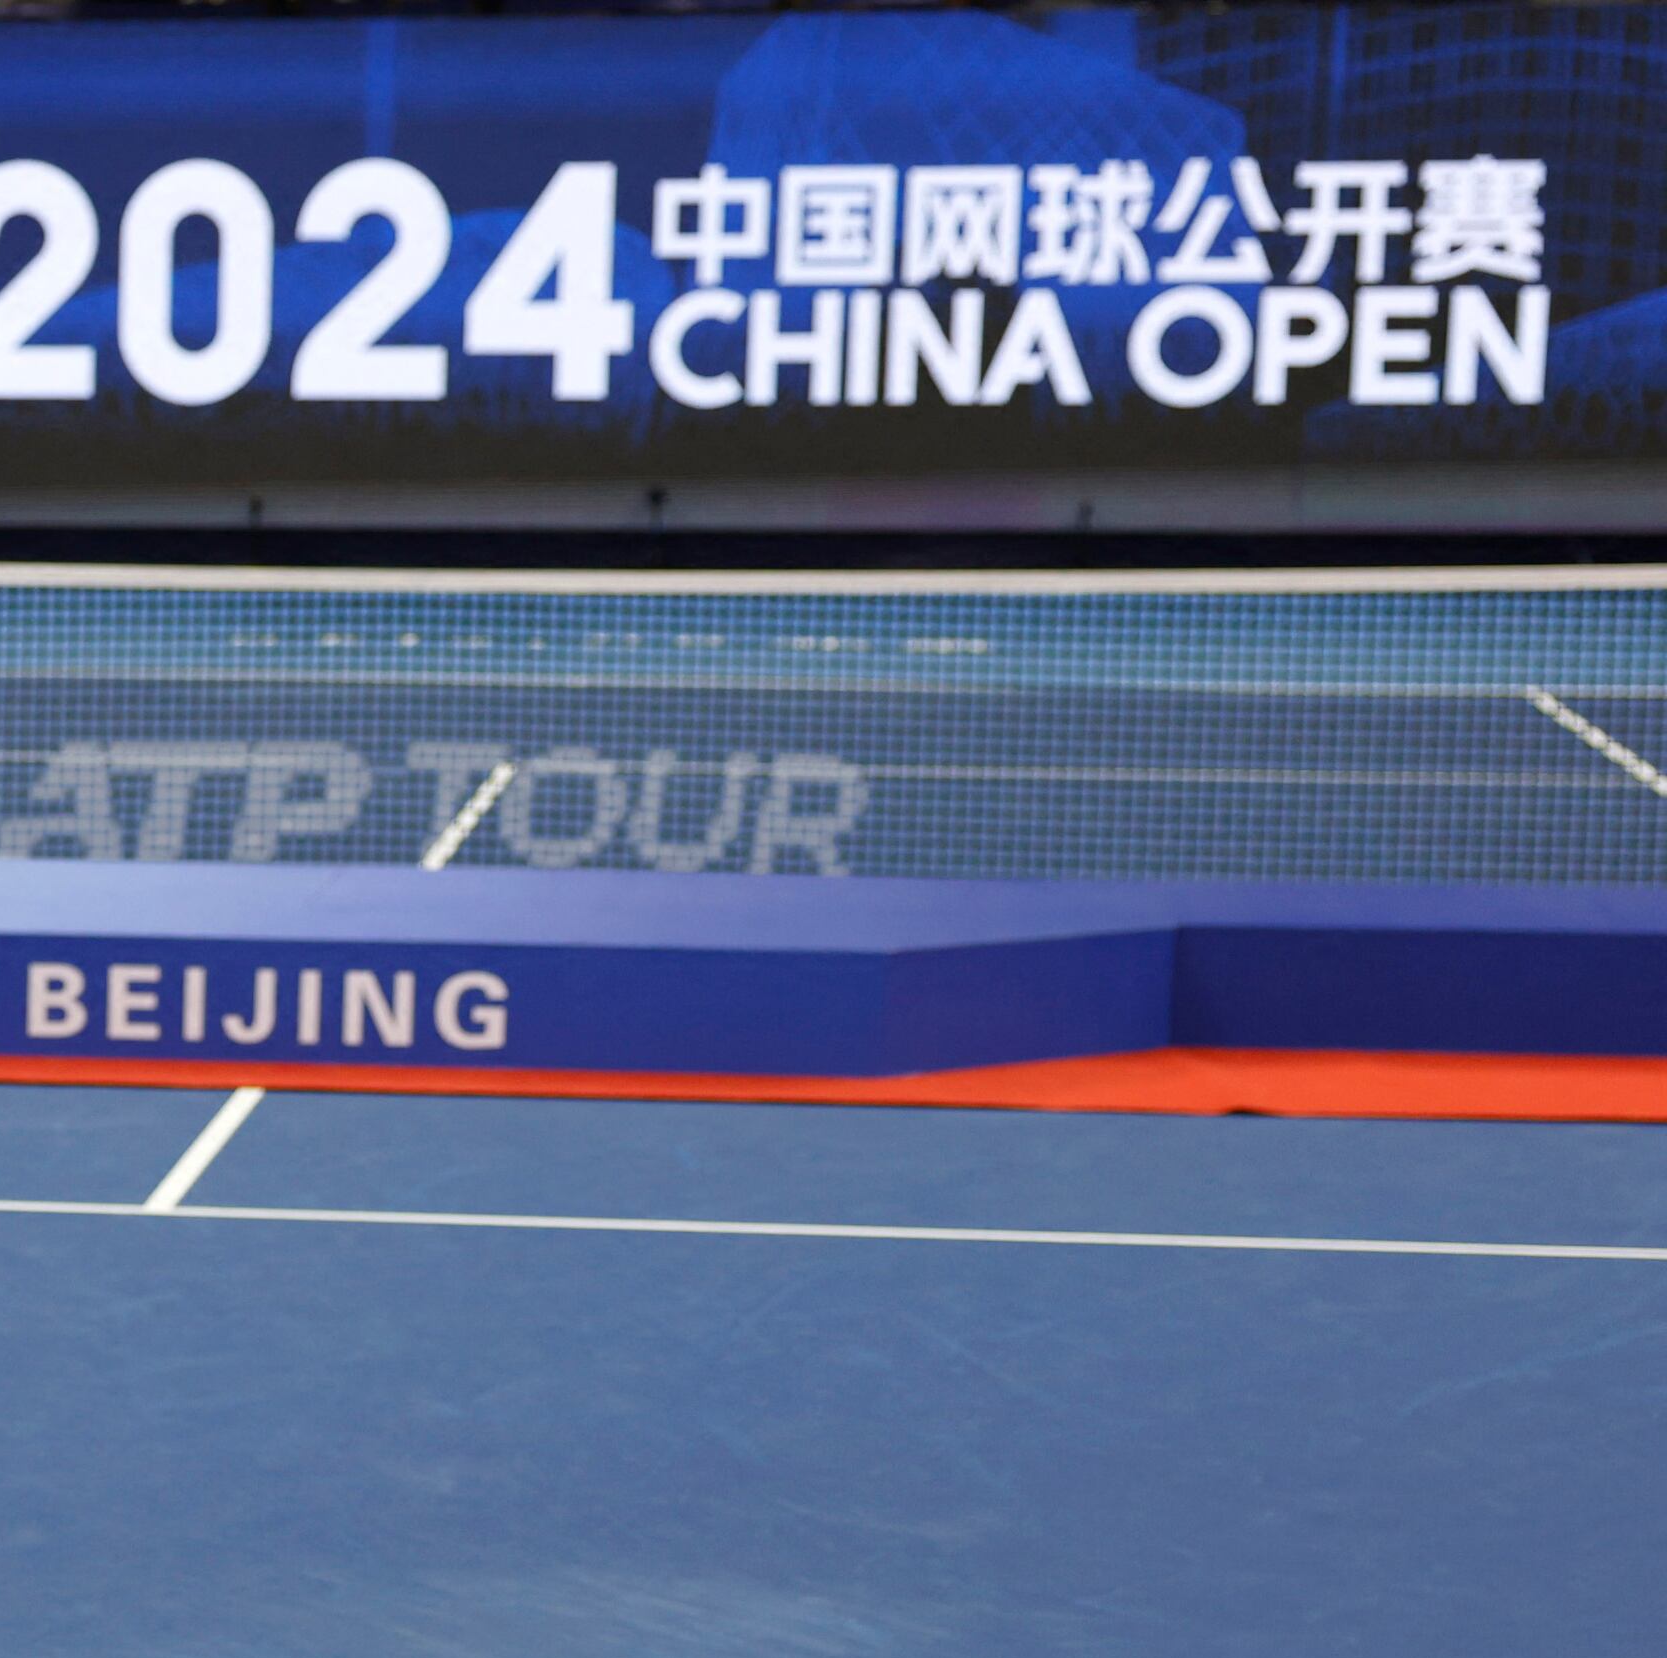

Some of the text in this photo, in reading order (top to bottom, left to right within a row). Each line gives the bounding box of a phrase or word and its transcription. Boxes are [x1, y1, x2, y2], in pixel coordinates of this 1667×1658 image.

[651, 154, 1547, 285] 中国网球公开赛
[649, 286, 1552, 409] CHINA OPEN
[406, 740, 868, 877] TOUR
[26, 961, 509, 1050] BEIJING
